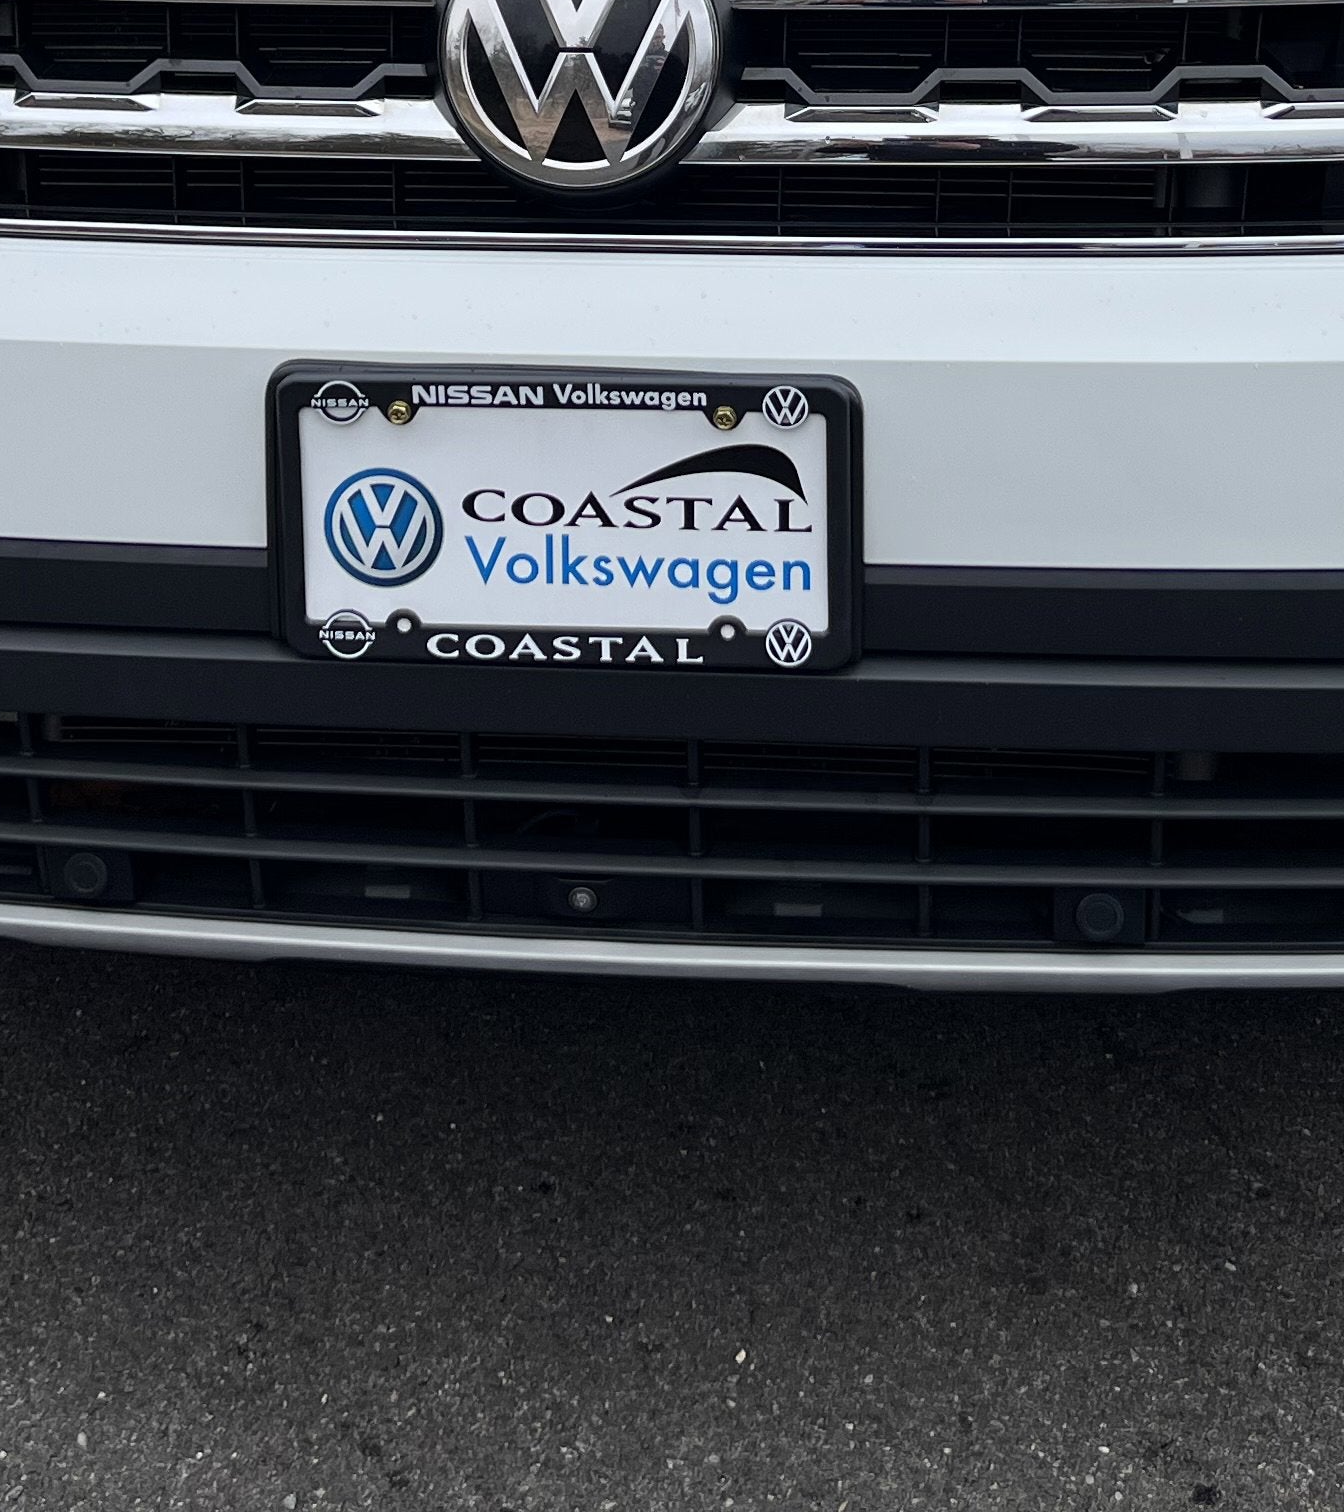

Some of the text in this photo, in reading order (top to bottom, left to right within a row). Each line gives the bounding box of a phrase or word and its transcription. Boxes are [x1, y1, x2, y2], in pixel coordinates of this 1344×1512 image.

[311, 398, 369, 408] NISSAN
[412, 383, 707, 410] NISSAN Volkswagen
[461, 488, 813, 533] COASTAL
[464, 533, 812, 605] Volkswagen
[319, 629, 376, 641] NISSAN
[426, 632, 704, 664] COASTAL
